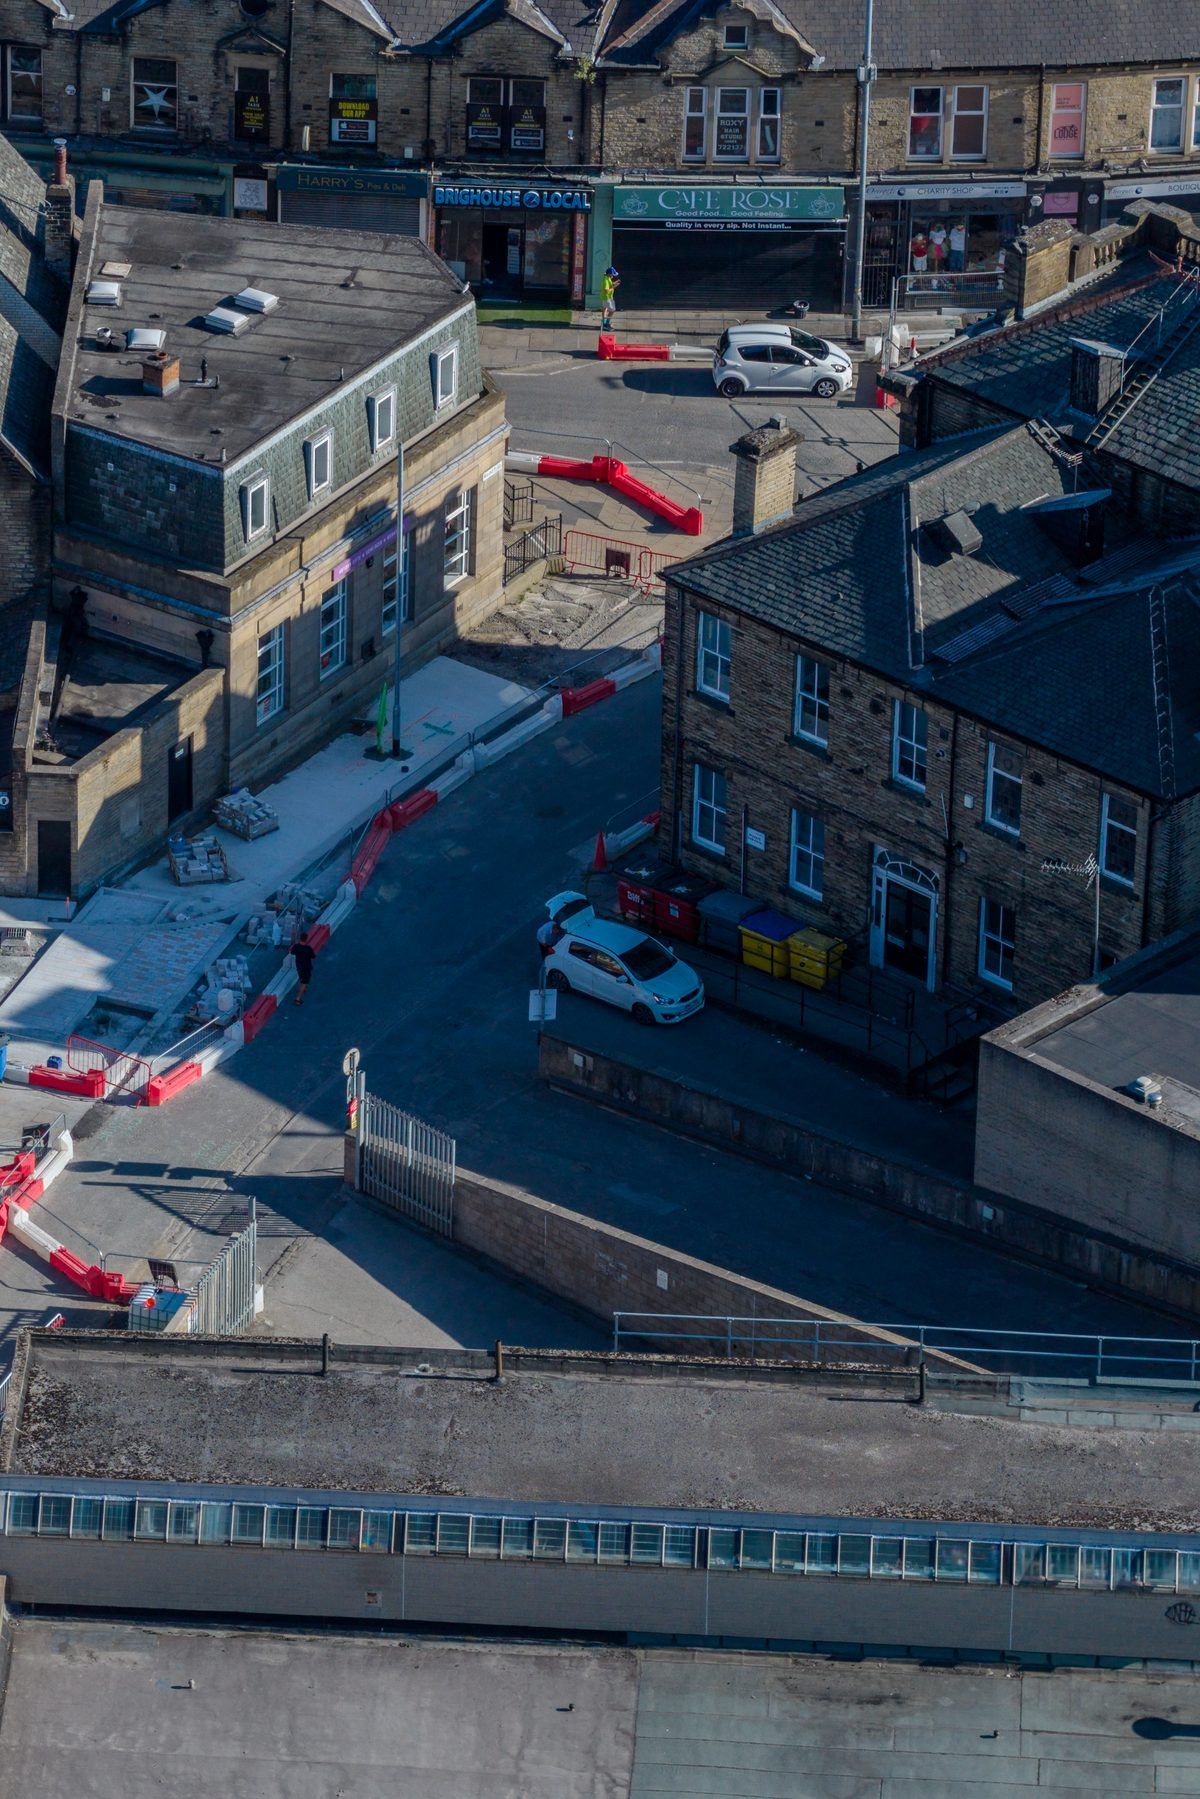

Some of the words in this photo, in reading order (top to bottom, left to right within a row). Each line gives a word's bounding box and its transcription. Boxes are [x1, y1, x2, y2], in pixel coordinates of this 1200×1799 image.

[338, 102, 369, 110] DOWNLOAD
[298, 174, 364, 190] HARRY'S
[917, 187, 951, 195] CHARITY
[435, 187, 521, 208] BRIGHOUSE
[543, 191, 591, 209] LOCAL
[658, 190, 720, 210] CAFE
[732, 191, 798, 210] ROSE
[665, 221, 693, 230] Quality
[726, 222, 741, 230] sip.
